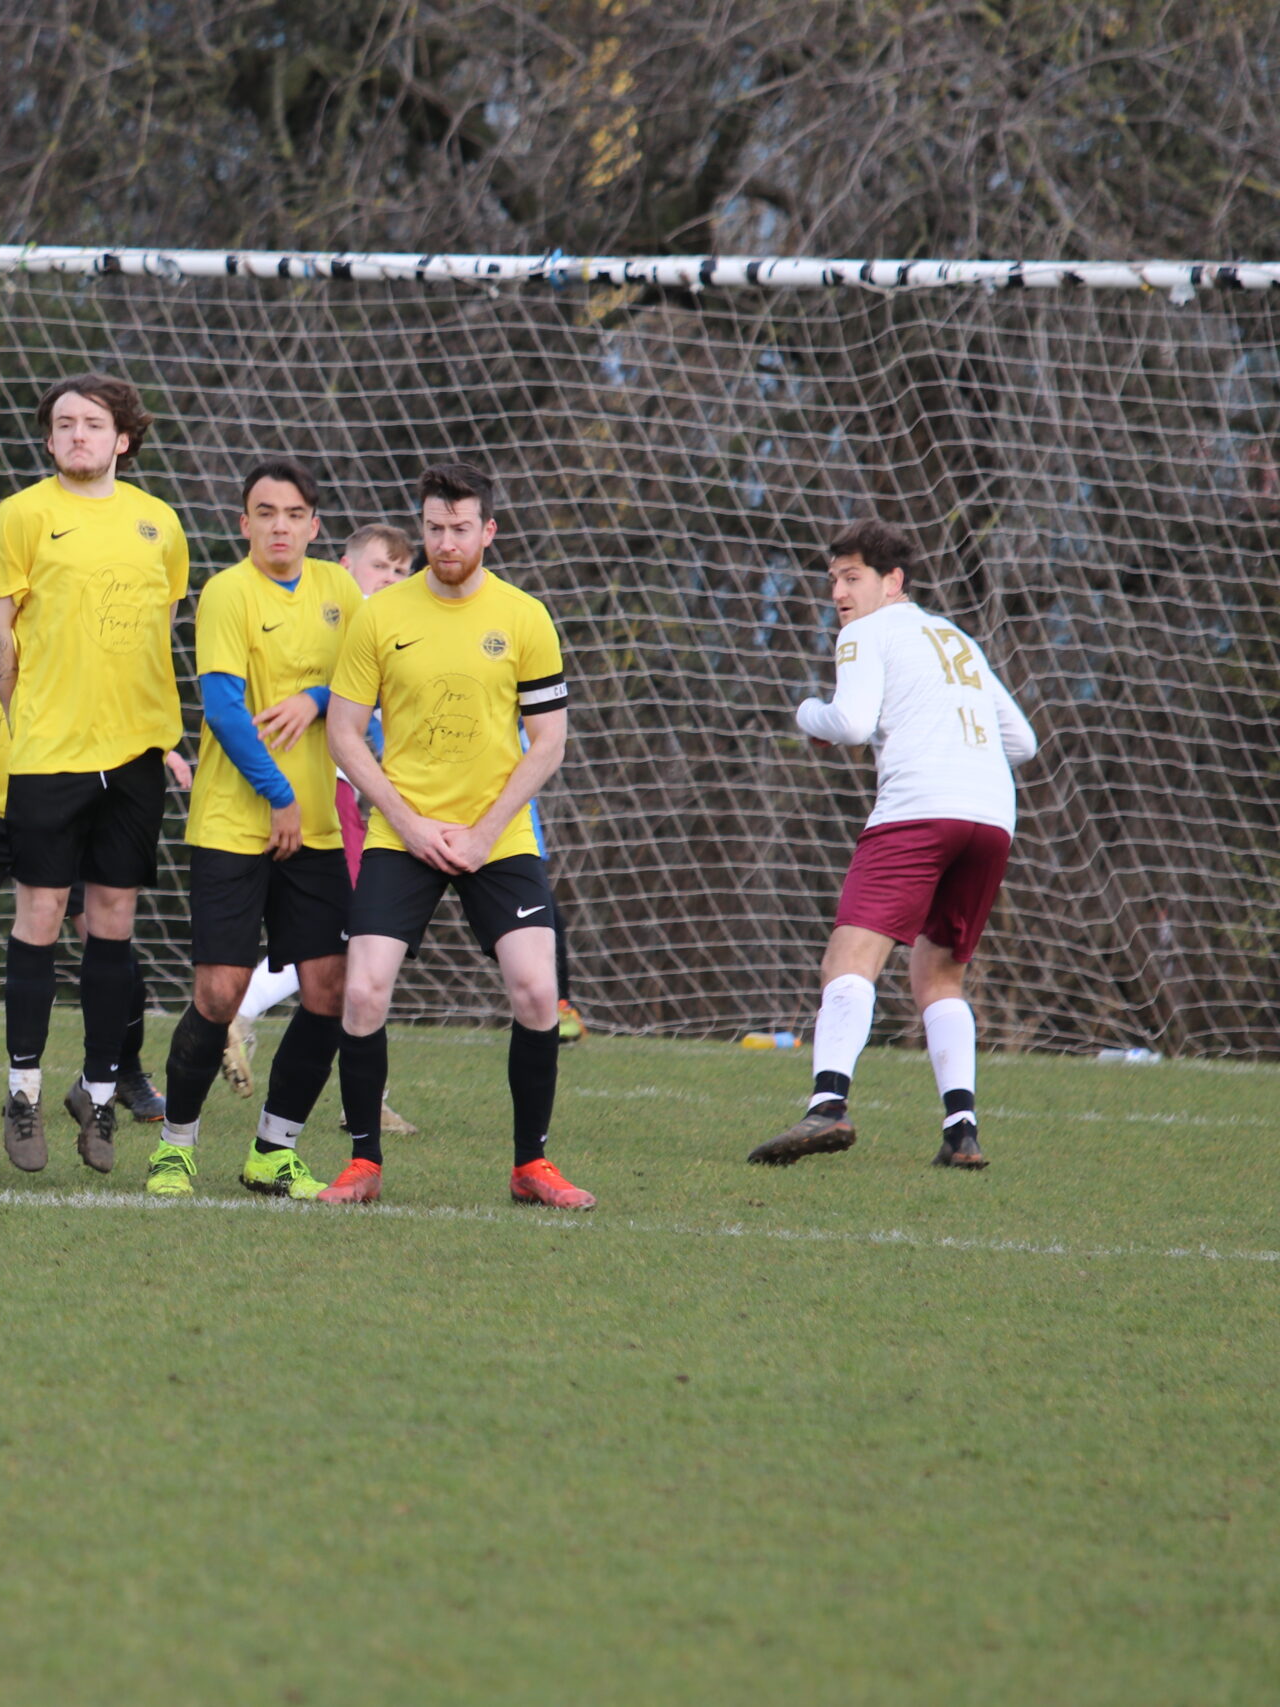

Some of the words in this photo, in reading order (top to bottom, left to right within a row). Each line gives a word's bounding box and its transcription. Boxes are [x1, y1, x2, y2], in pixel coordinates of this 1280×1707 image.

[100, 568, 138, 606] Jon
[94, 603, 145, 637] Frank
[921, 625, 982, 690] 12
[432, 679, 474, 716] Jon
[423, 713, 482, 746] Frank
